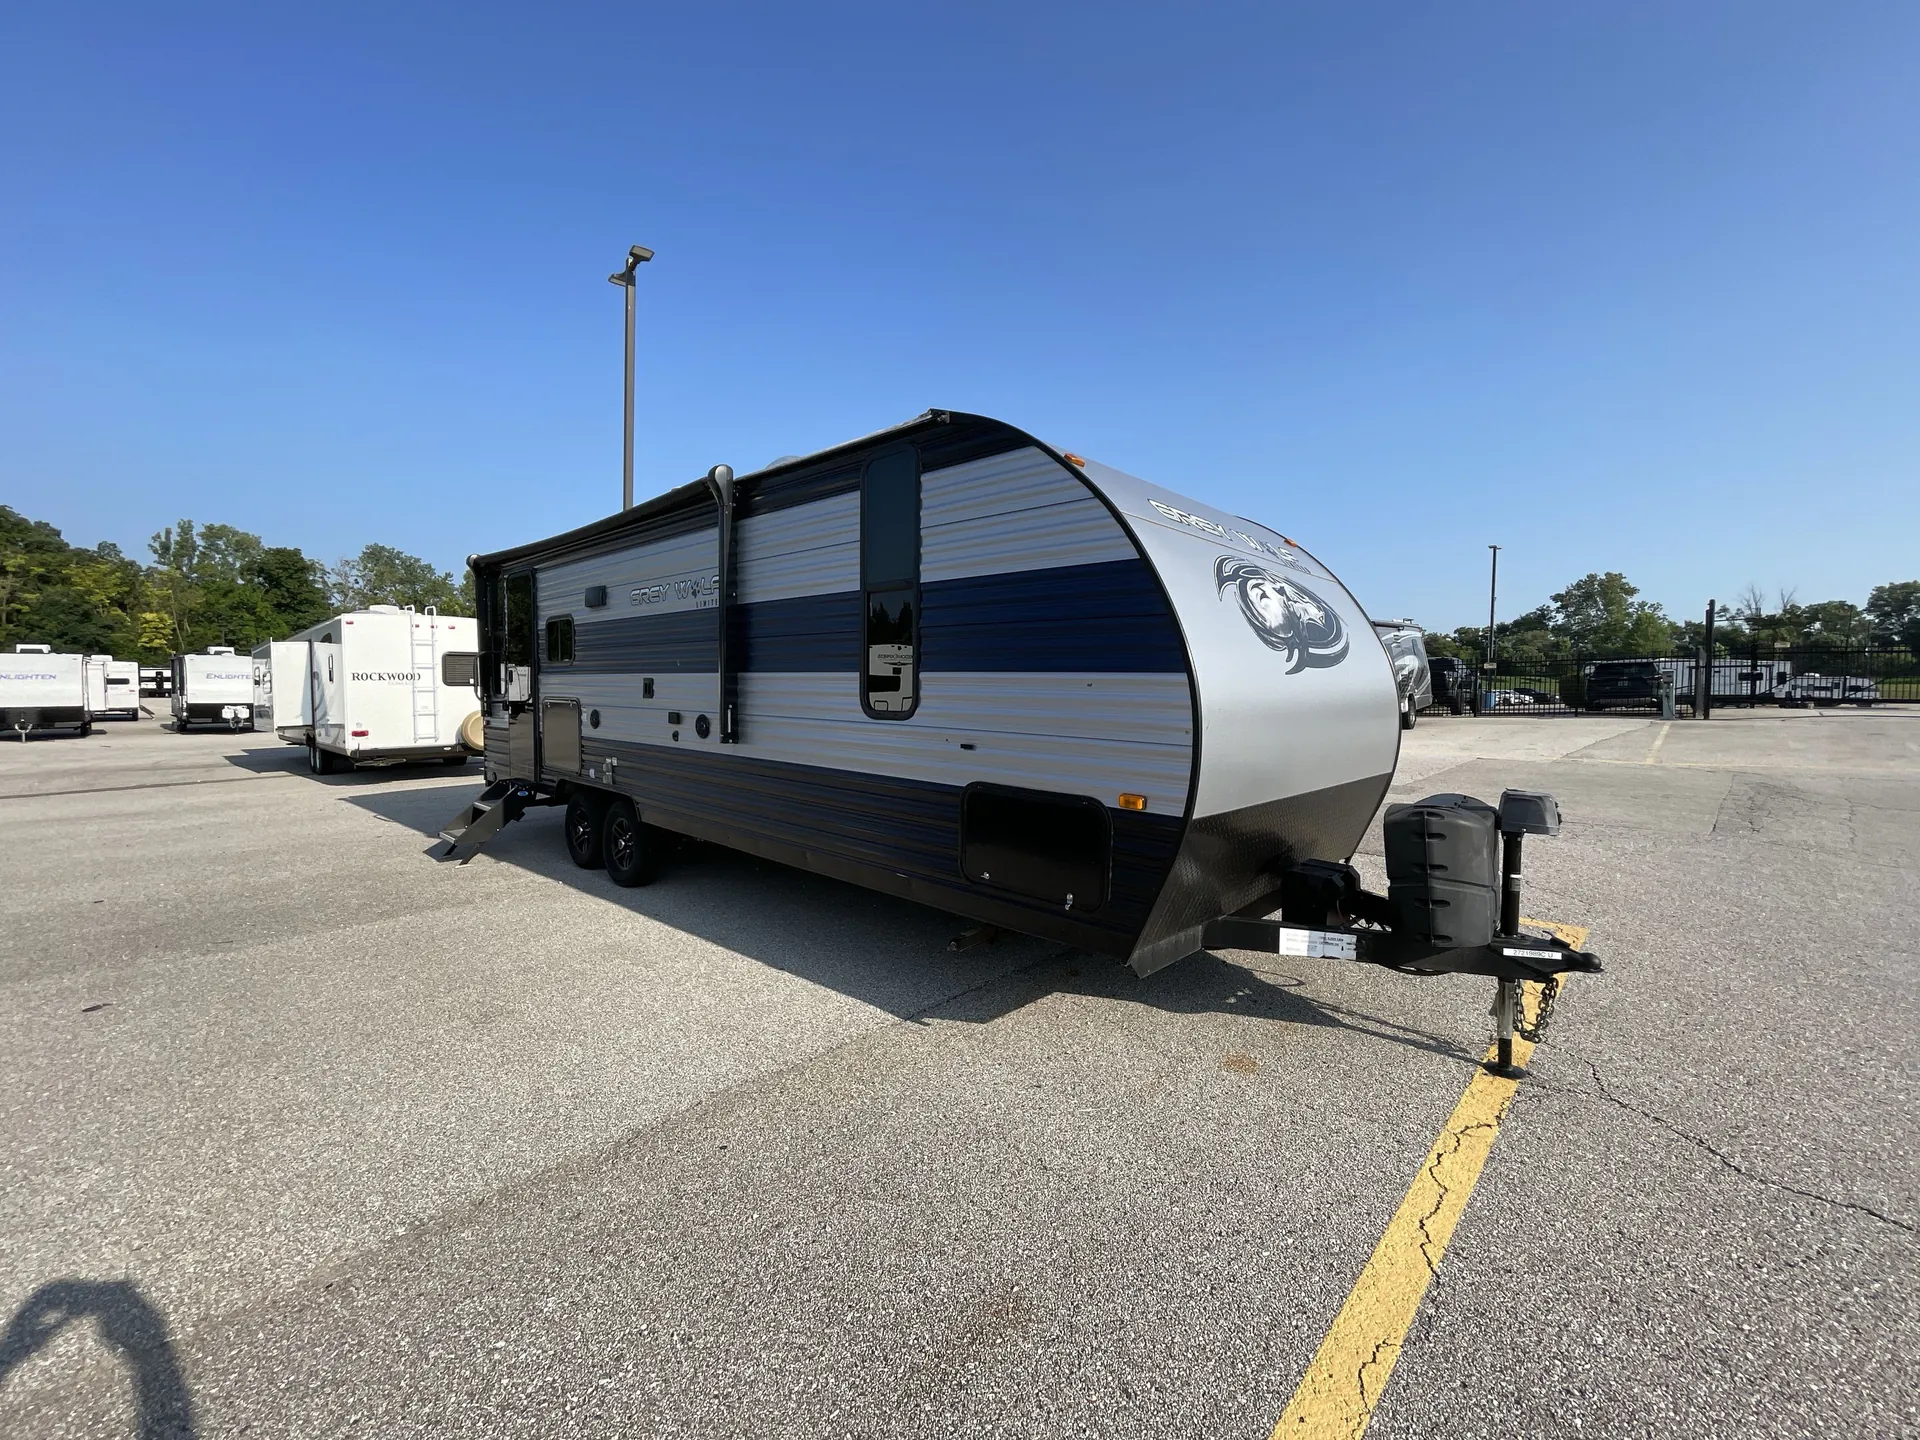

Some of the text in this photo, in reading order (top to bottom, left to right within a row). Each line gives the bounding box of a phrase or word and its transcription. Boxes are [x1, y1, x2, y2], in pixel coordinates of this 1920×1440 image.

[1147, 498, 1233, 541] GREY
[629, 583, 670, 606] GREY
[696, 598, 719, 608] LIMITE
[351, 672, 421, 681] ROCKWOOD
